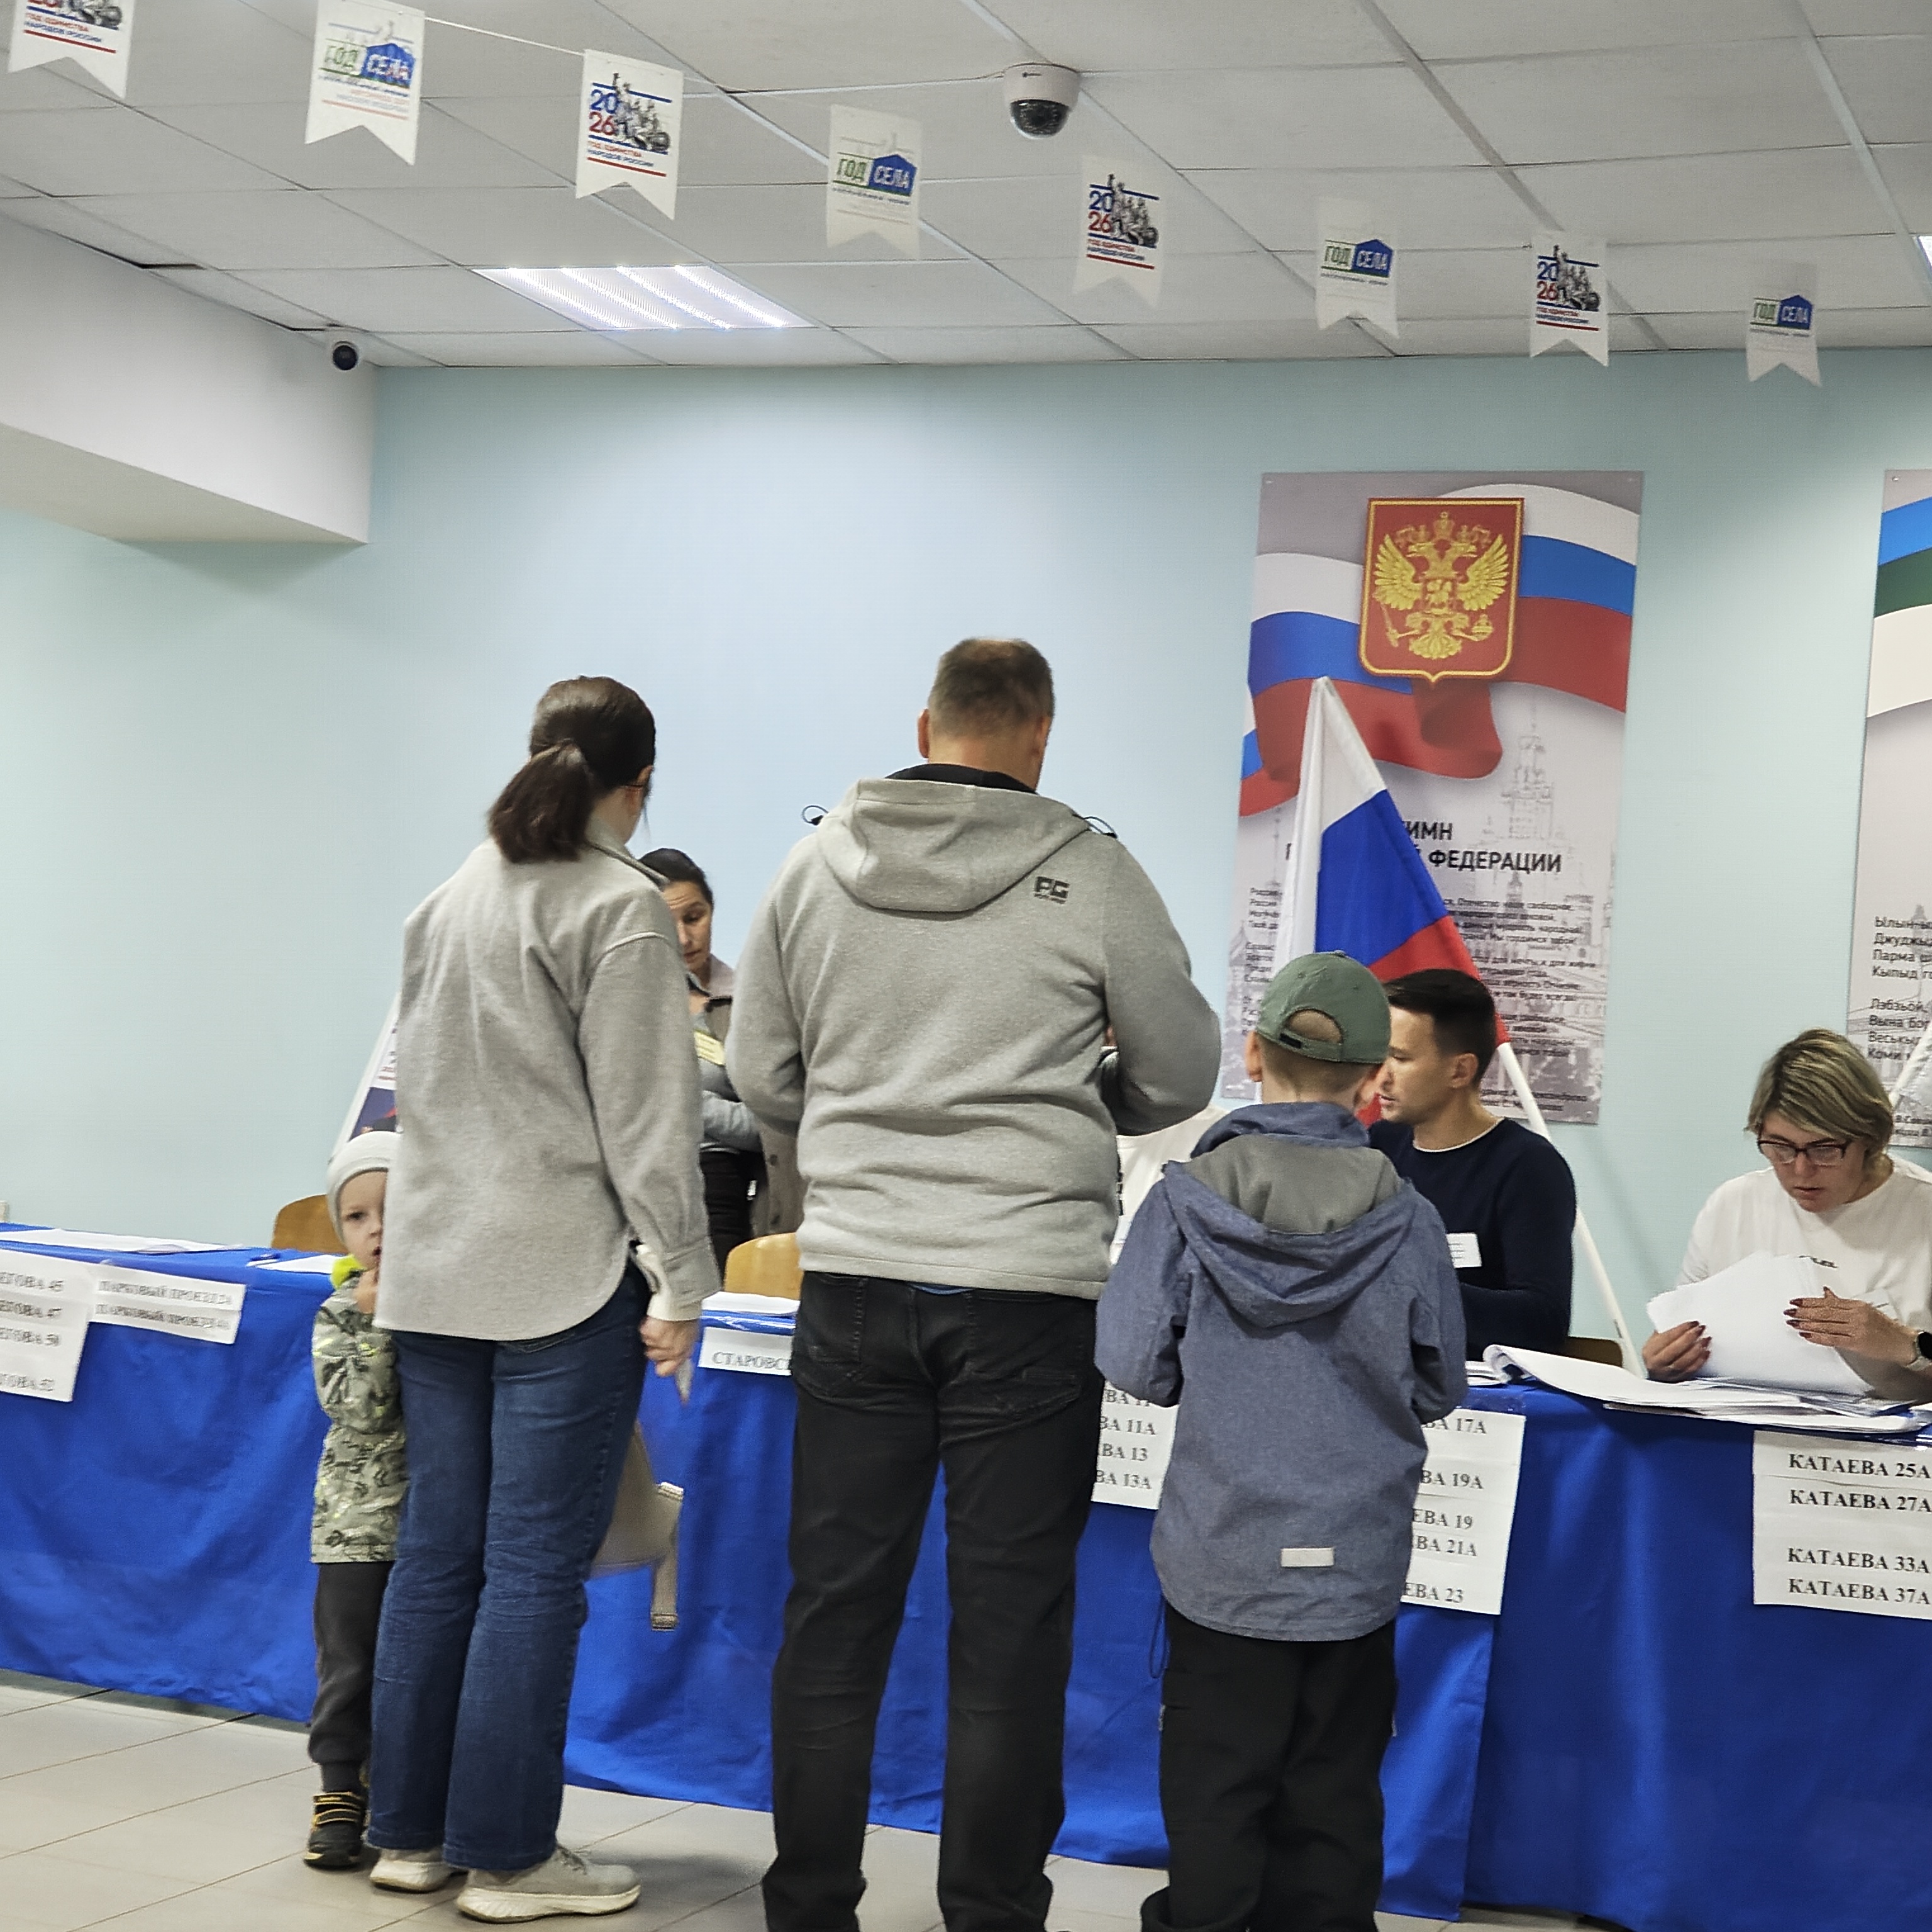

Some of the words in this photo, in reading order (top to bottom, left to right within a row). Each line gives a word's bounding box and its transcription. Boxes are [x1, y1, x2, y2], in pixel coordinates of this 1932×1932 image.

[590, 89, 620, 114] 20
[588, 111, 615, 136] 26
[836, 158, 868, 183] ГОД
[1088, 191, 1114, 213] 20
[1087, 211, 1113, 233] 26
[1536, 281, 1558, 301] 26
[1402, 821, 1453, 841] ИМН
[1428, 849, 1562, 875] ФЕДЕРАЦИИ
[1872, 949, 1914, 963] Парма
[1872, 965, 1918, 980] Кыпыд
[1869, 1014, 1902, 1027] Вына
[1127, 1419, 1157, 1436] 11А
[1456, 1418, 1487, 1434] 17А
[1131, 1447, 1148, 1462] 13
[1789, 1453, 1889, 1477] КАТАЕВА
[1894, 1462, 1931, 1479] 25А
[1123, 1473, 1152, 1489] 13А
[1453, 1473, 1484, 1489] 19А
[1790, 1489, 1890, 1510] КАТАЕВА
[1896, 1496, 1932, 1513] 27А
[1455, 1515, 1473, 1530] 19
[1446, 1539, 1477, 1557] 21А
[1788, 1547, 1889, 1570] КАТАЕВА
[1893, 1556, 1931, 1574] 33А
[1445, 1588, 1464, 1604] 23
[1789, 1578, 1889, 1602] КАТАЕВА
[1894, 1587, 1931, 1606] 37А
